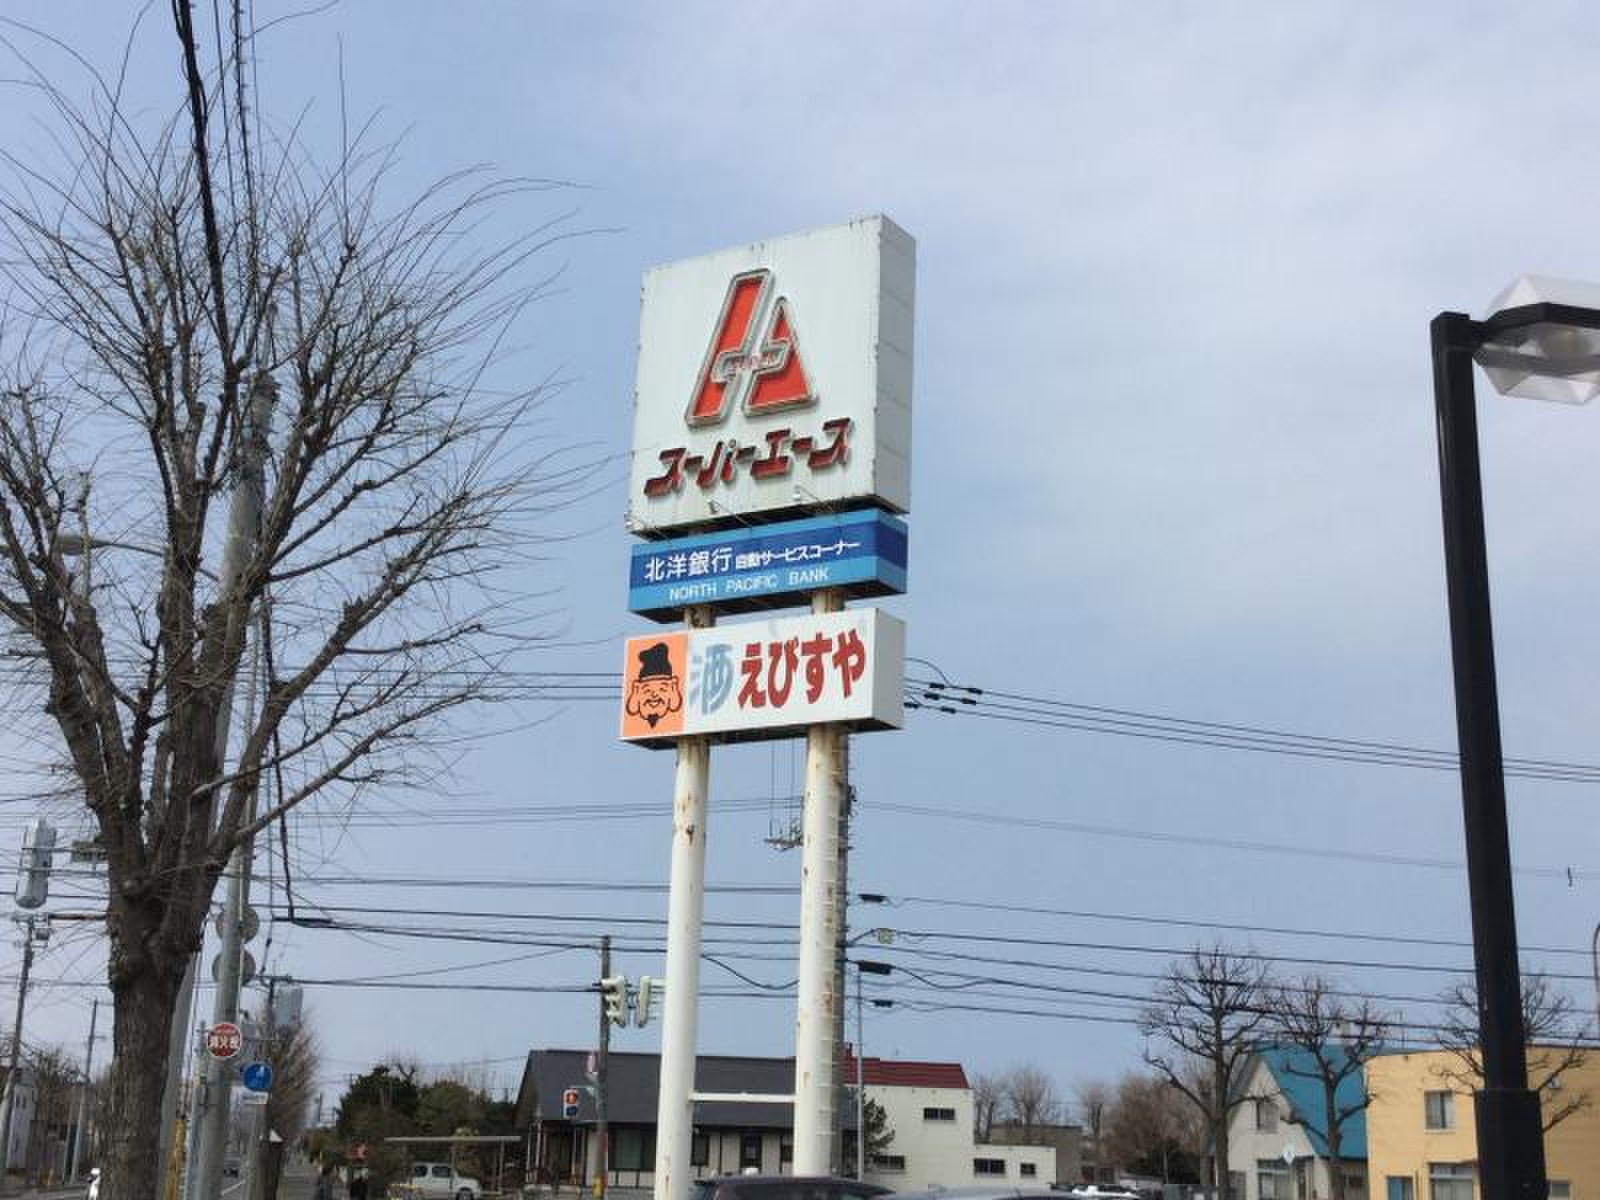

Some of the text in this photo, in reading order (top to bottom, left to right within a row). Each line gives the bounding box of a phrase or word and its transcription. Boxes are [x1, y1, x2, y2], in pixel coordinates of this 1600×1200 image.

[643, 416, 853, 498] スーパーエース
[644, 539, 861, 583] 北洋銀行 自動サービスコーナー
[669, 565, 829, 601] NORTH PACIFIC BANK
[737, 629, 866, 710] えびすや
